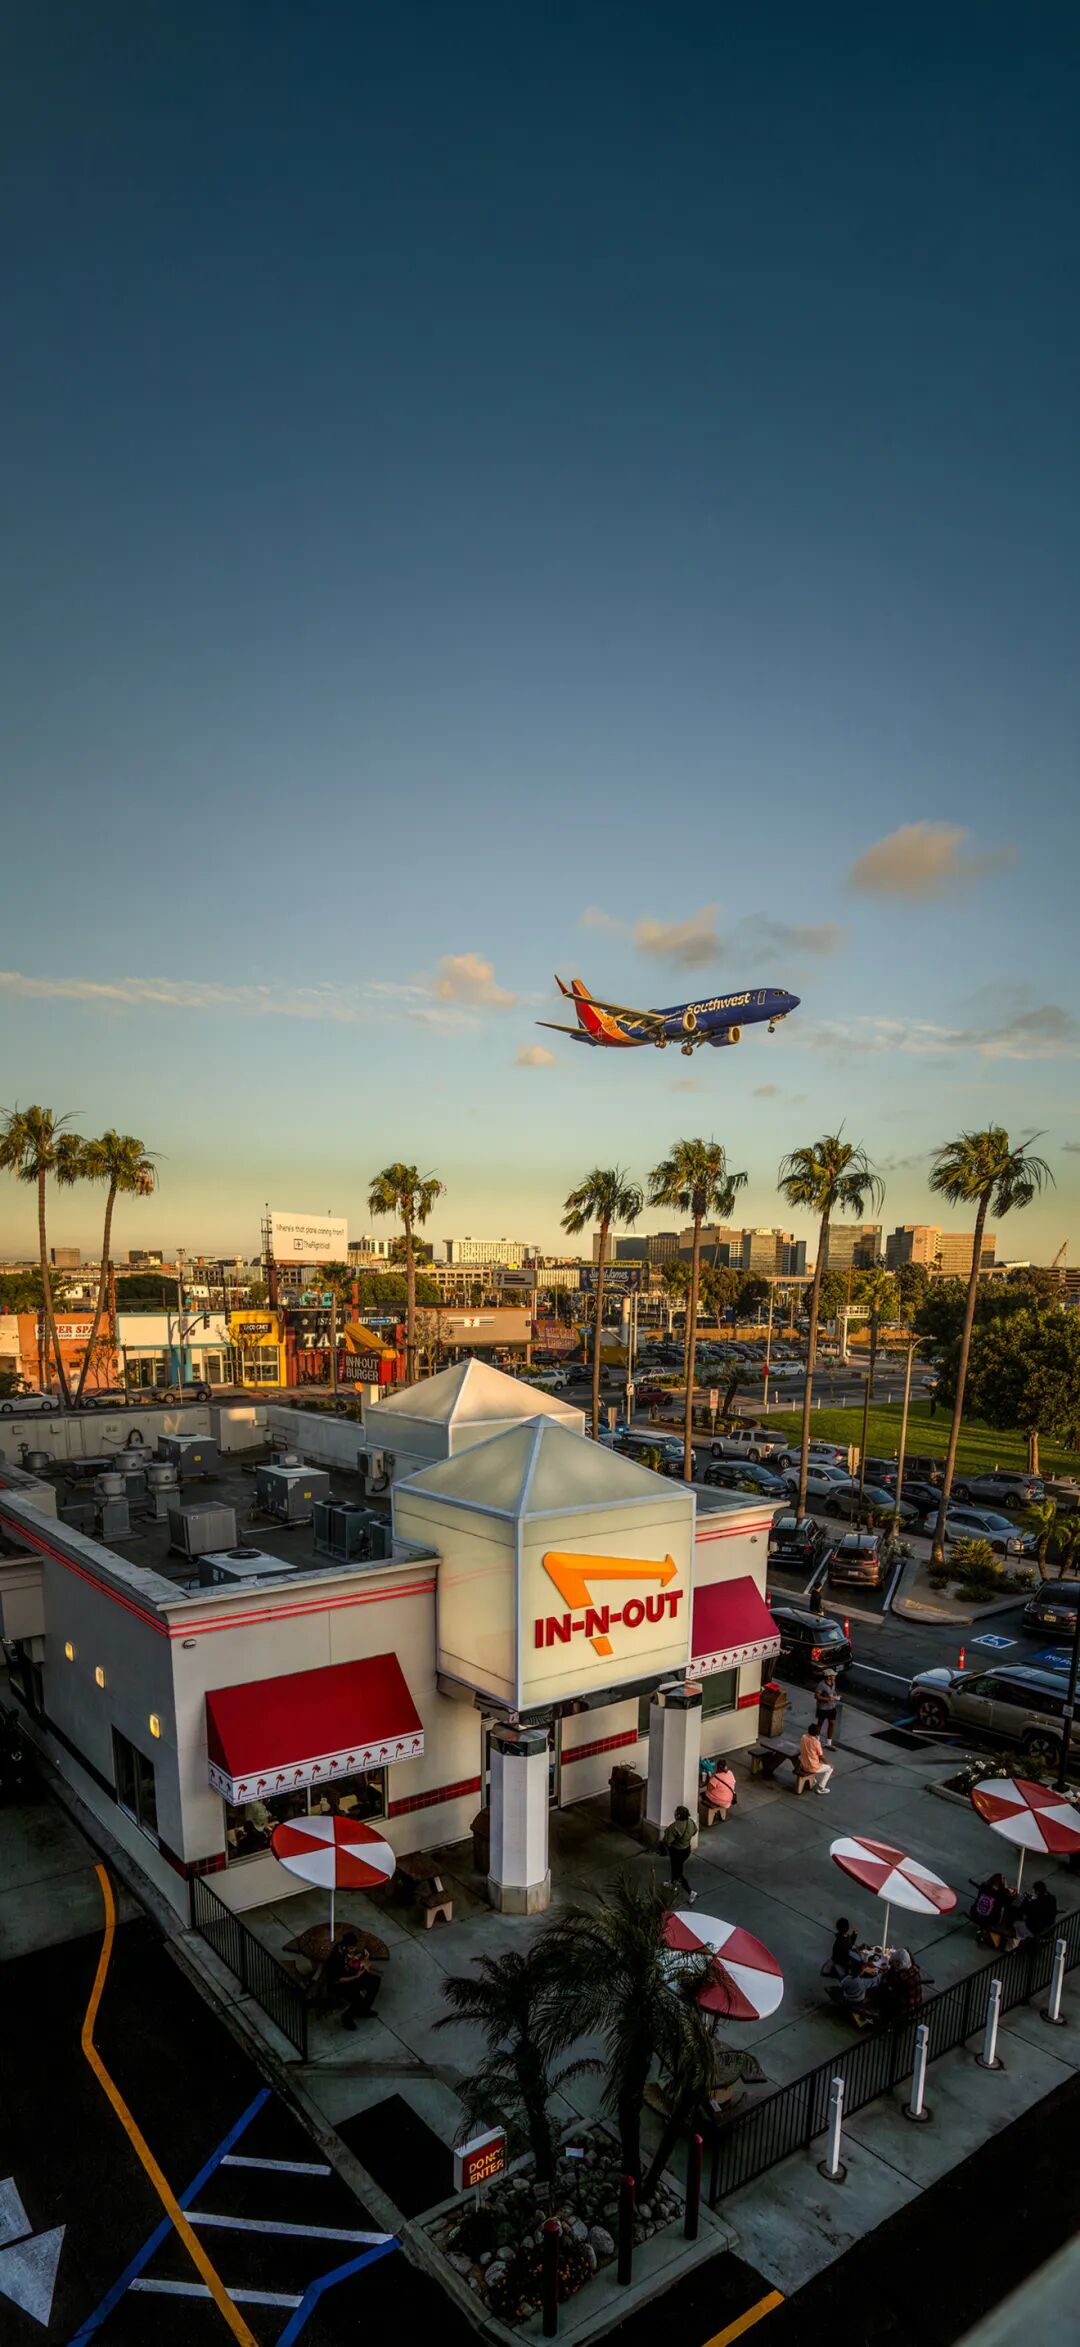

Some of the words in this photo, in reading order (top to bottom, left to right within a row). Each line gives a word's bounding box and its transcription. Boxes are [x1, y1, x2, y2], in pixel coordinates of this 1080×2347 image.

[687, 992, 750, 1014] Southwest
[346, 1355, 379, 1369] IN-N-OUT
[346, 1367, 379, 1381] BURGER
[535, 1589, 684, 1649] IN-N-OUT
[469, 2158, 484, 2175] DO
[470, 2158, 504, 2185] ENTER
